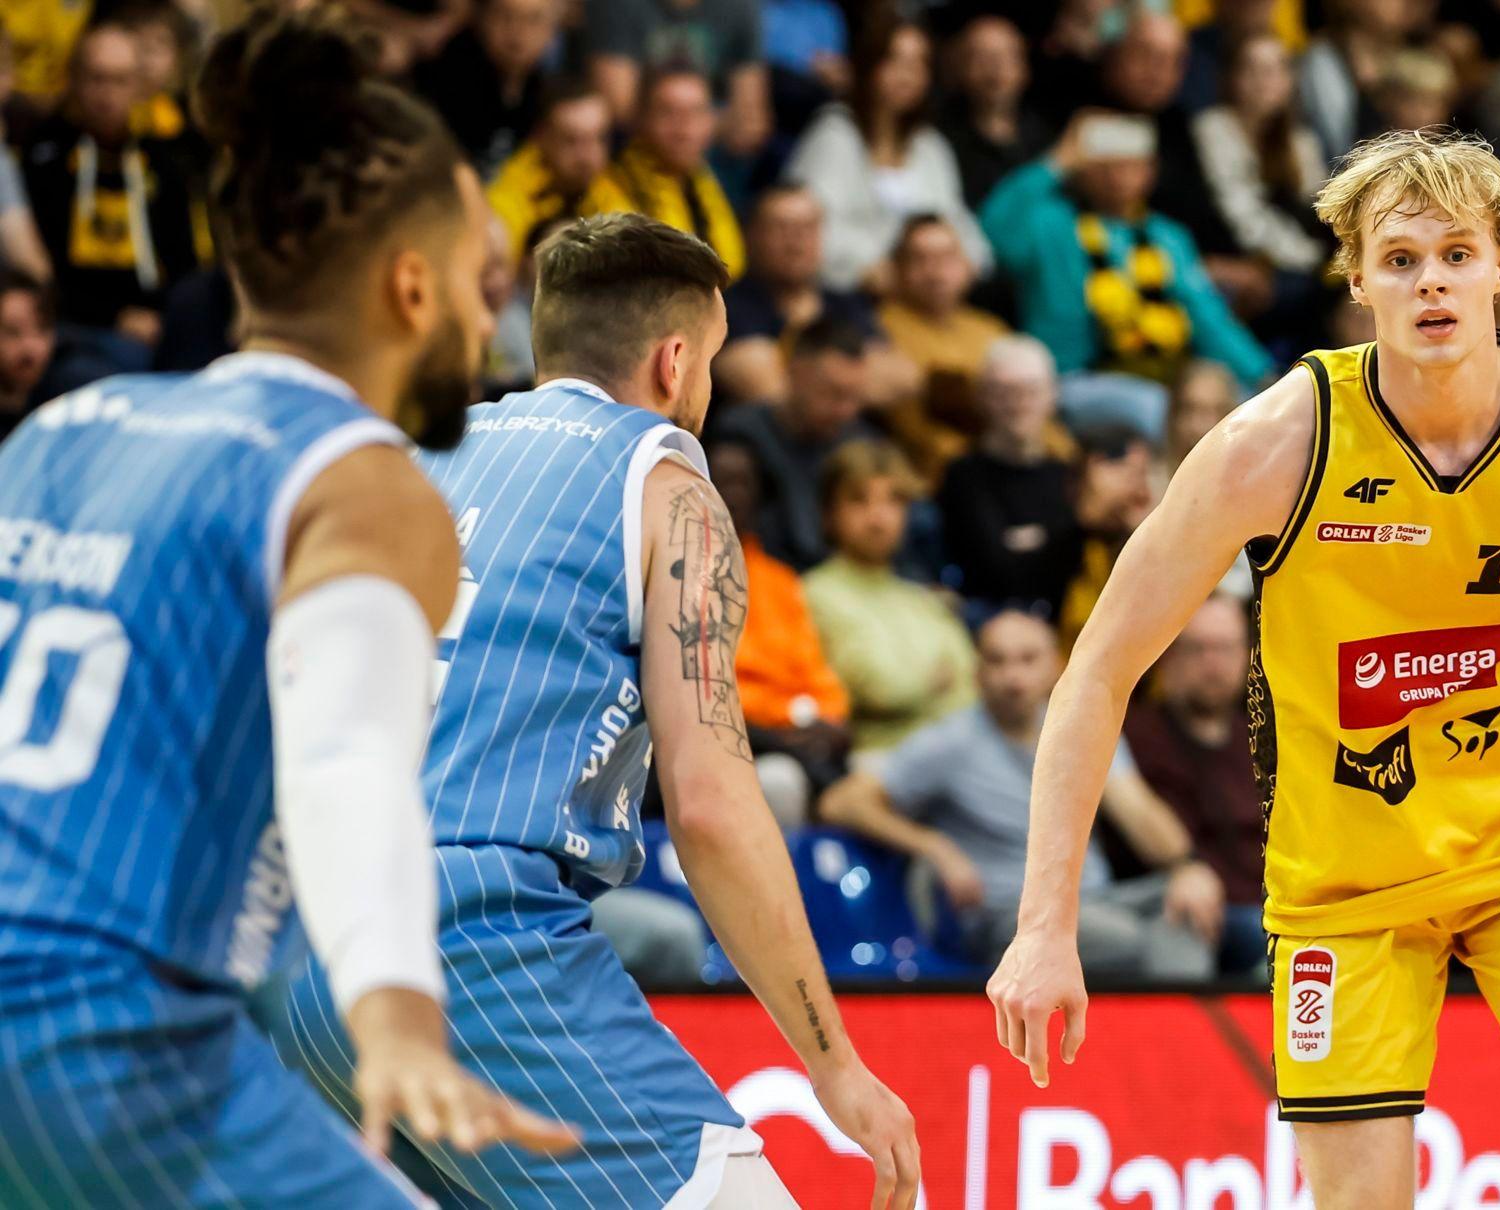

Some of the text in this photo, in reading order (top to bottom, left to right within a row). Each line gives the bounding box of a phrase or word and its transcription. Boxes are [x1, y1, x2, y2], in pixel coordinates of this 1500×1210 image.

[1343, 477, 1396, 504] 4F
[1322, 526, 1371, 539] ORLEN
[1397, 525, 1427, 535] Basket
[1395, 533, 1414, 542] Liga
[1394, 648, 1496, 679] Energa
[1399, 686, 1443, 702] GRUPA
[1361, 744, 1407, 790] Trefl
[1295, 963, 1331, 973] ORLEN
[1291, 1030, 1326, 1039] Basket
[1297, 1041, 1319, 1052] Liga
